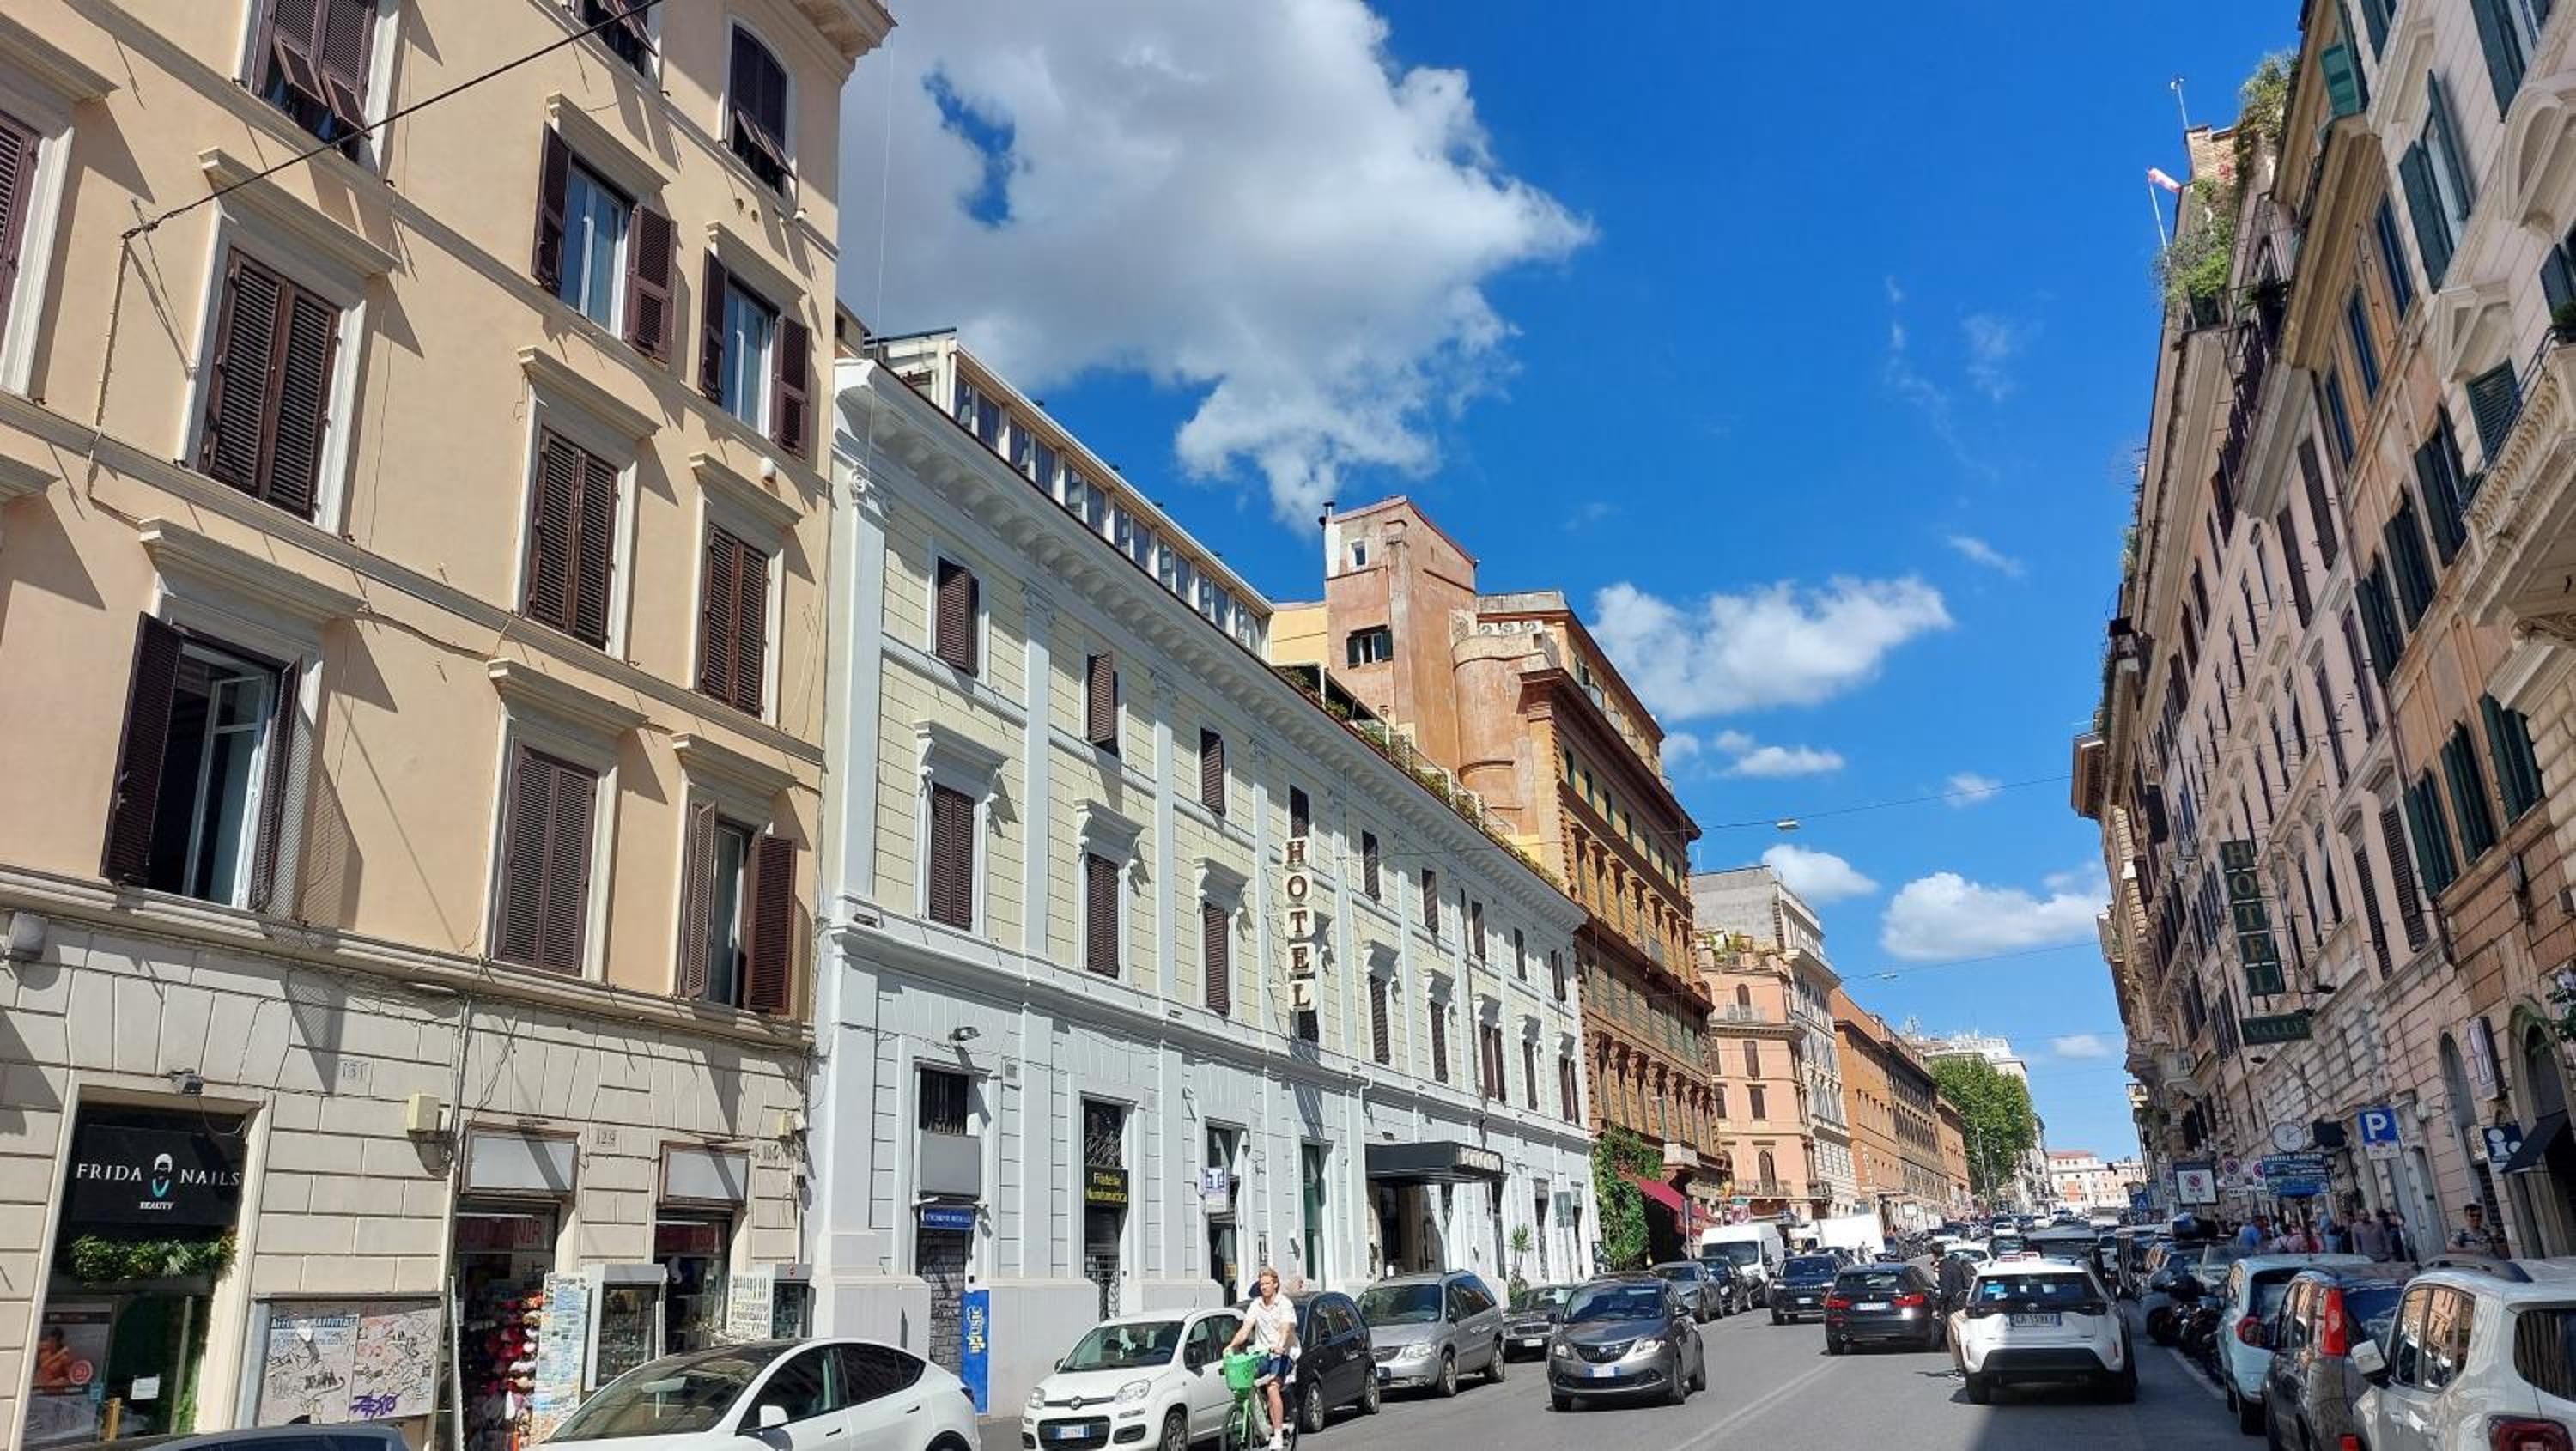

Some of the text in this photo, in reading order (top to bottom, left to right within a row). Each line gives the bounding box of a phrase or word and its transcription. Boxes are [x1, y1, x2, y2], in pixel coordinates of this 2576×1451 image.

[1286, 840, 1311, 1007] HOTEL
[2226, 843, 2279, 991] HOTEL
[2366, 1114, 2387, 1139] P
[76, 1163, 240, 1187] FRIDA NAILS
[139, 1201, 174, 1211] BEAUTY
